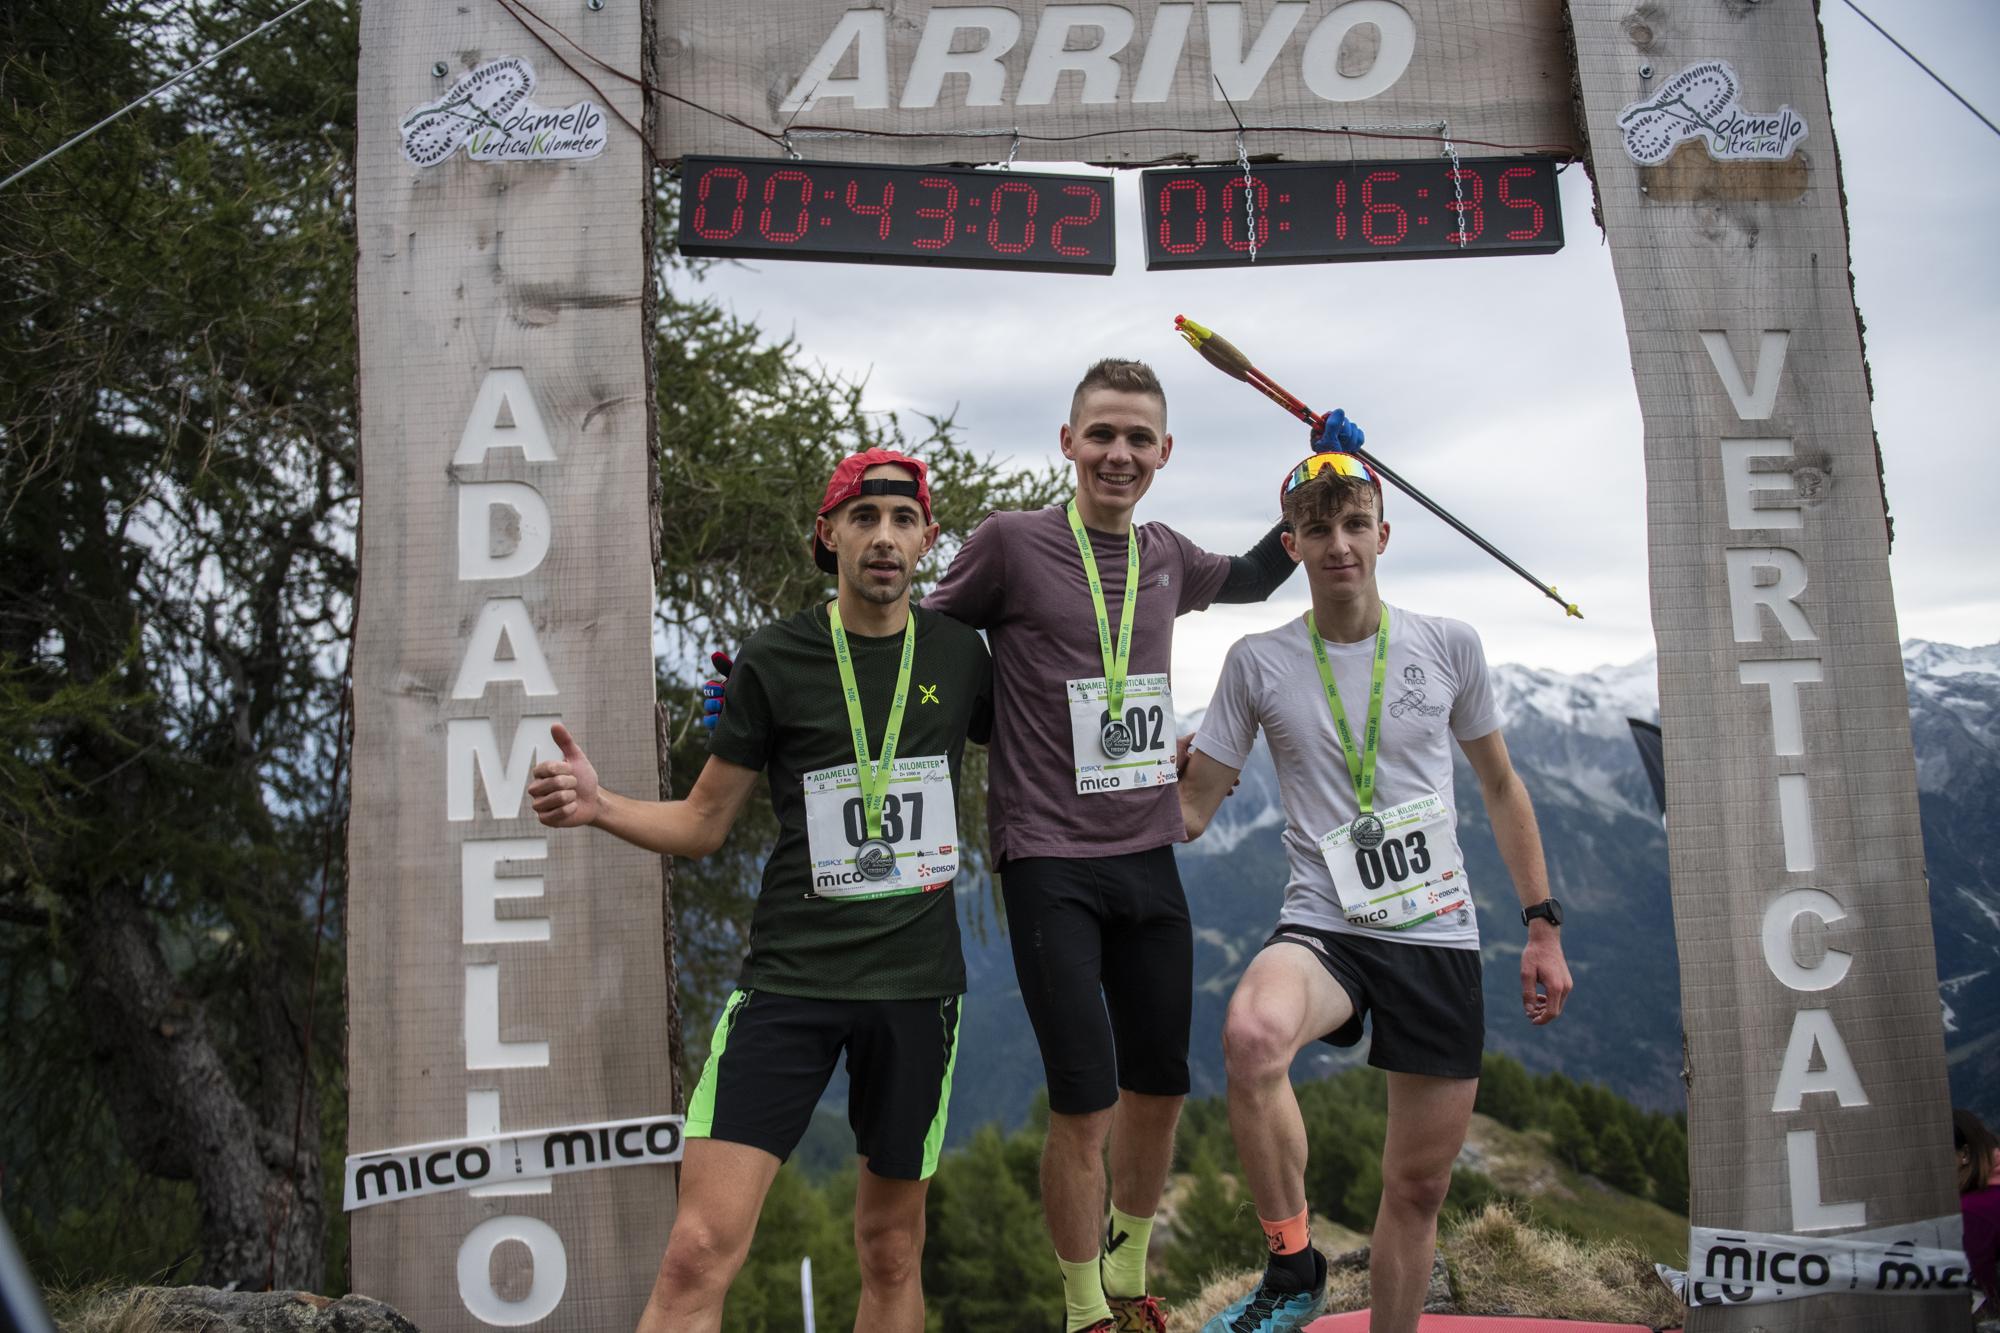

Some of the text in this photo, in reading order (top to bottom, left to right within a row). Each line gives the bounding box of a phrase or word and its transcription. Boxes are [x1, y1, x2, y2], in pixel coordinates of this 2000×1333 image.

[778, 0, 1417, 112] ARRIVO
[693, 167, 1101, 256] 00:43:02
[813, 767, 858, 783] ADAMELLO
[899, 760, 940, 771] KILOMETER
[1698, 329, 1870, 1232] VERTICAL
[842, 791, 924, 848] 037
[1397, 798, 1436, 816] KILOMETER
[816, 871, 865, 887] mico
[1354, 830, 1431, 891] 003
[355, 1147, 491, 1200] mico
[543, 1122, 680, 1169] mico
[1705, 1236, 1831, 1286] mico
[1875, 1252, 1974, 1290] mic
